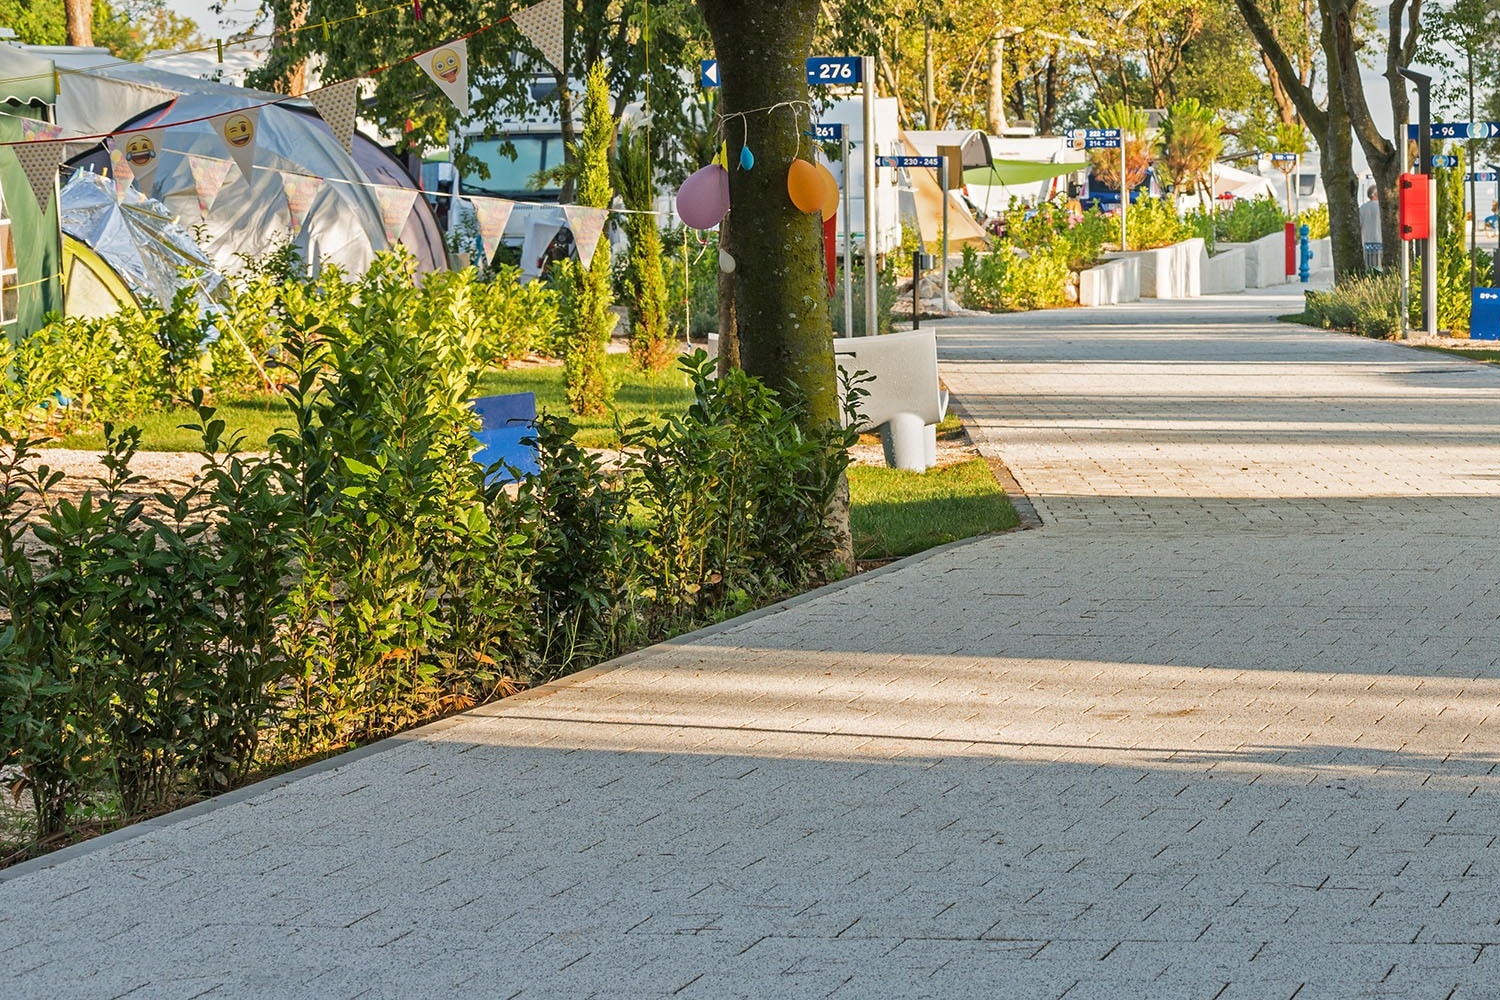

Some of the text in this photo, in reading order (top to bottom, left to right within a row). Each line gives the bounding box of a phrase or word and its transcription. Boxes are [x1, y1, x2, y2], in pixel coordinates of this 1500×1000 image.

[819, 63, 852, 79] 276
[816, 126, 834, 137] 261
[1441, 127, 1455, 136] 96
[903, 158, 918, 166] 230
[923, 158, 939, 166] 245
